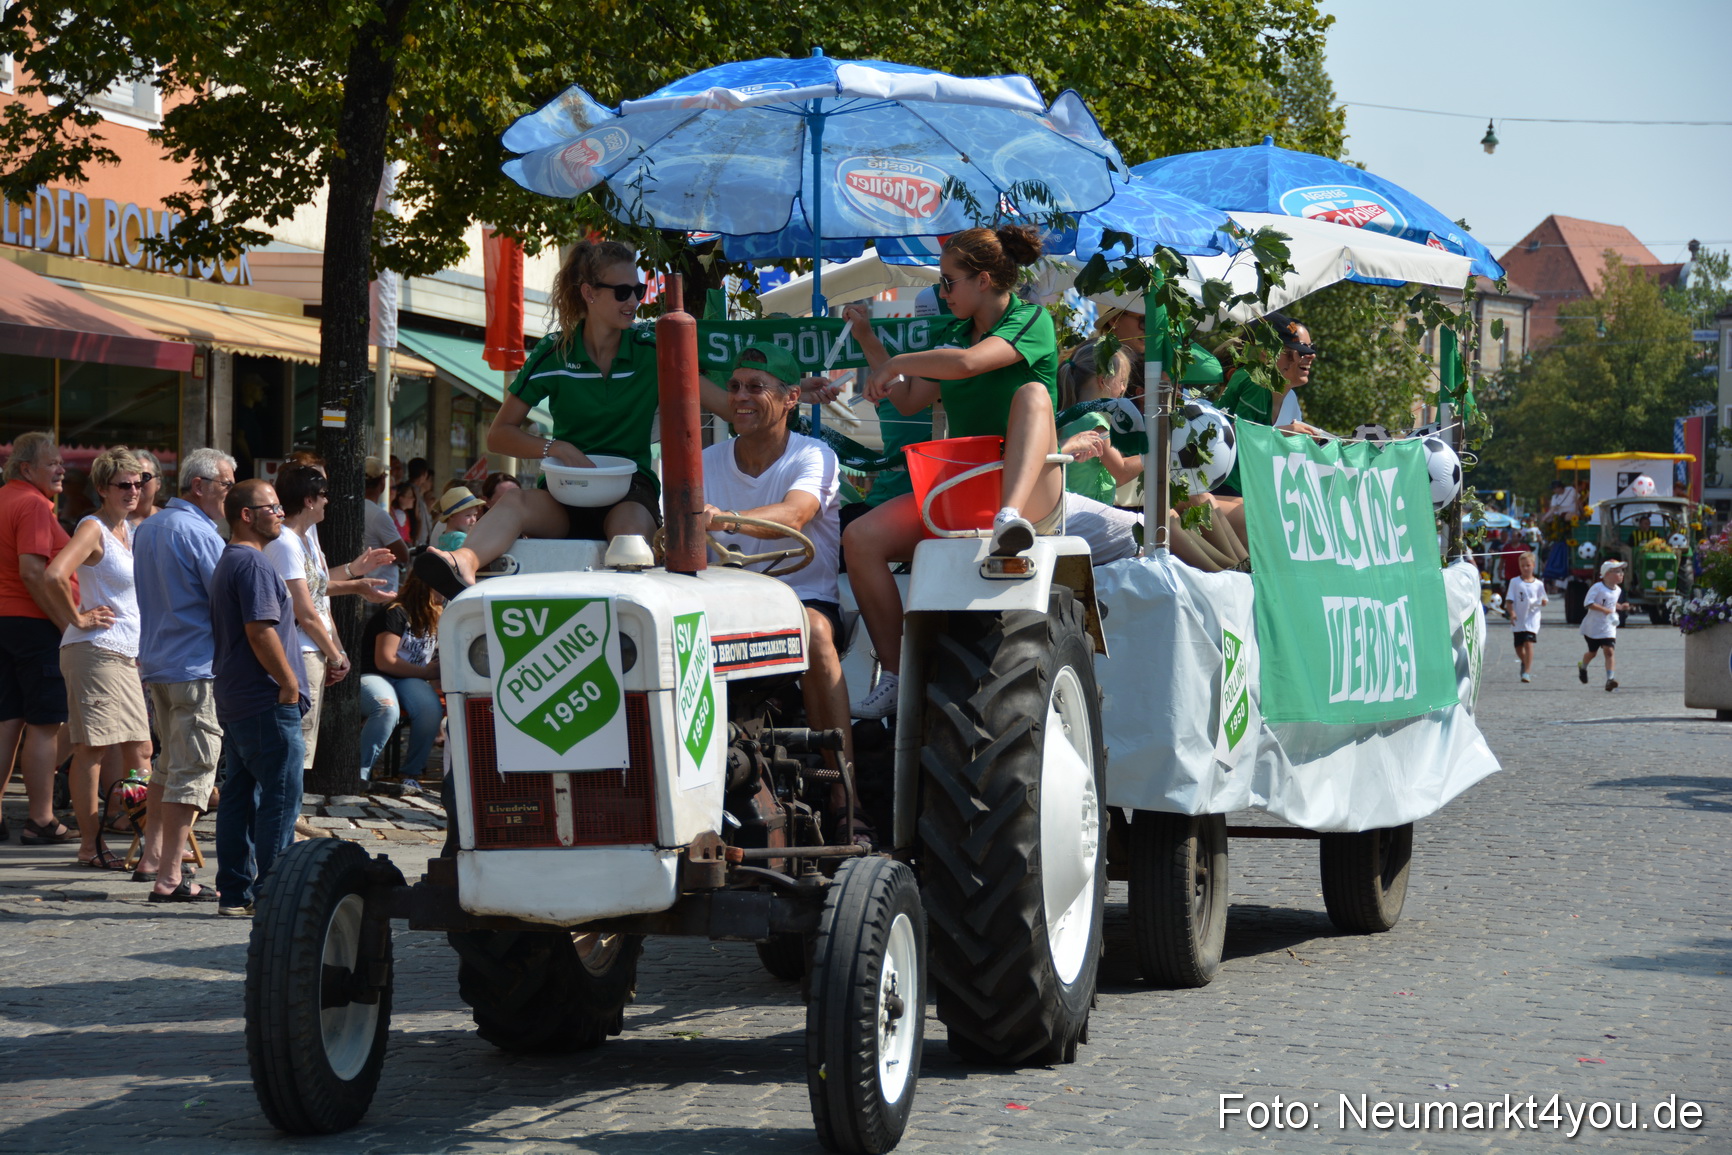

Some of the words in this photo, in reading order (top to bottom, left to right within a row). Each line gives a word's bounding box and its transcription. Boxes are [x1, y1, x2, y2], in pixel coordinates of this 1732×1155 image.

[1300, 188, 1348, 201] Nestlé
[3, 184, 90, 256] LEDER
[773, 320, 931, 364] PÖLLNG
[502, 607, 550, 638] SV
[677, 622, 691, 654] SV
[1464, 620, 1474, 645] SV
[506, 623, 599, 704] PÖLLING
[718, 642, 748, 663] BROWN
[749, 639, 787, 658] SELECTAMATIC
[1225, 636, 1236, 662] SV
[680, 637, 707, 721] PÖLLING
[1224, 657, 1245, 710] PÖLLING
[543, 680, 601, 732] 1950
[692, 695, 710, 747] 1950
[1230, 701, 1246, 735] 1950
[489, 803, 539, 813] Livedrive
[505, 815, 523, 825] 12
